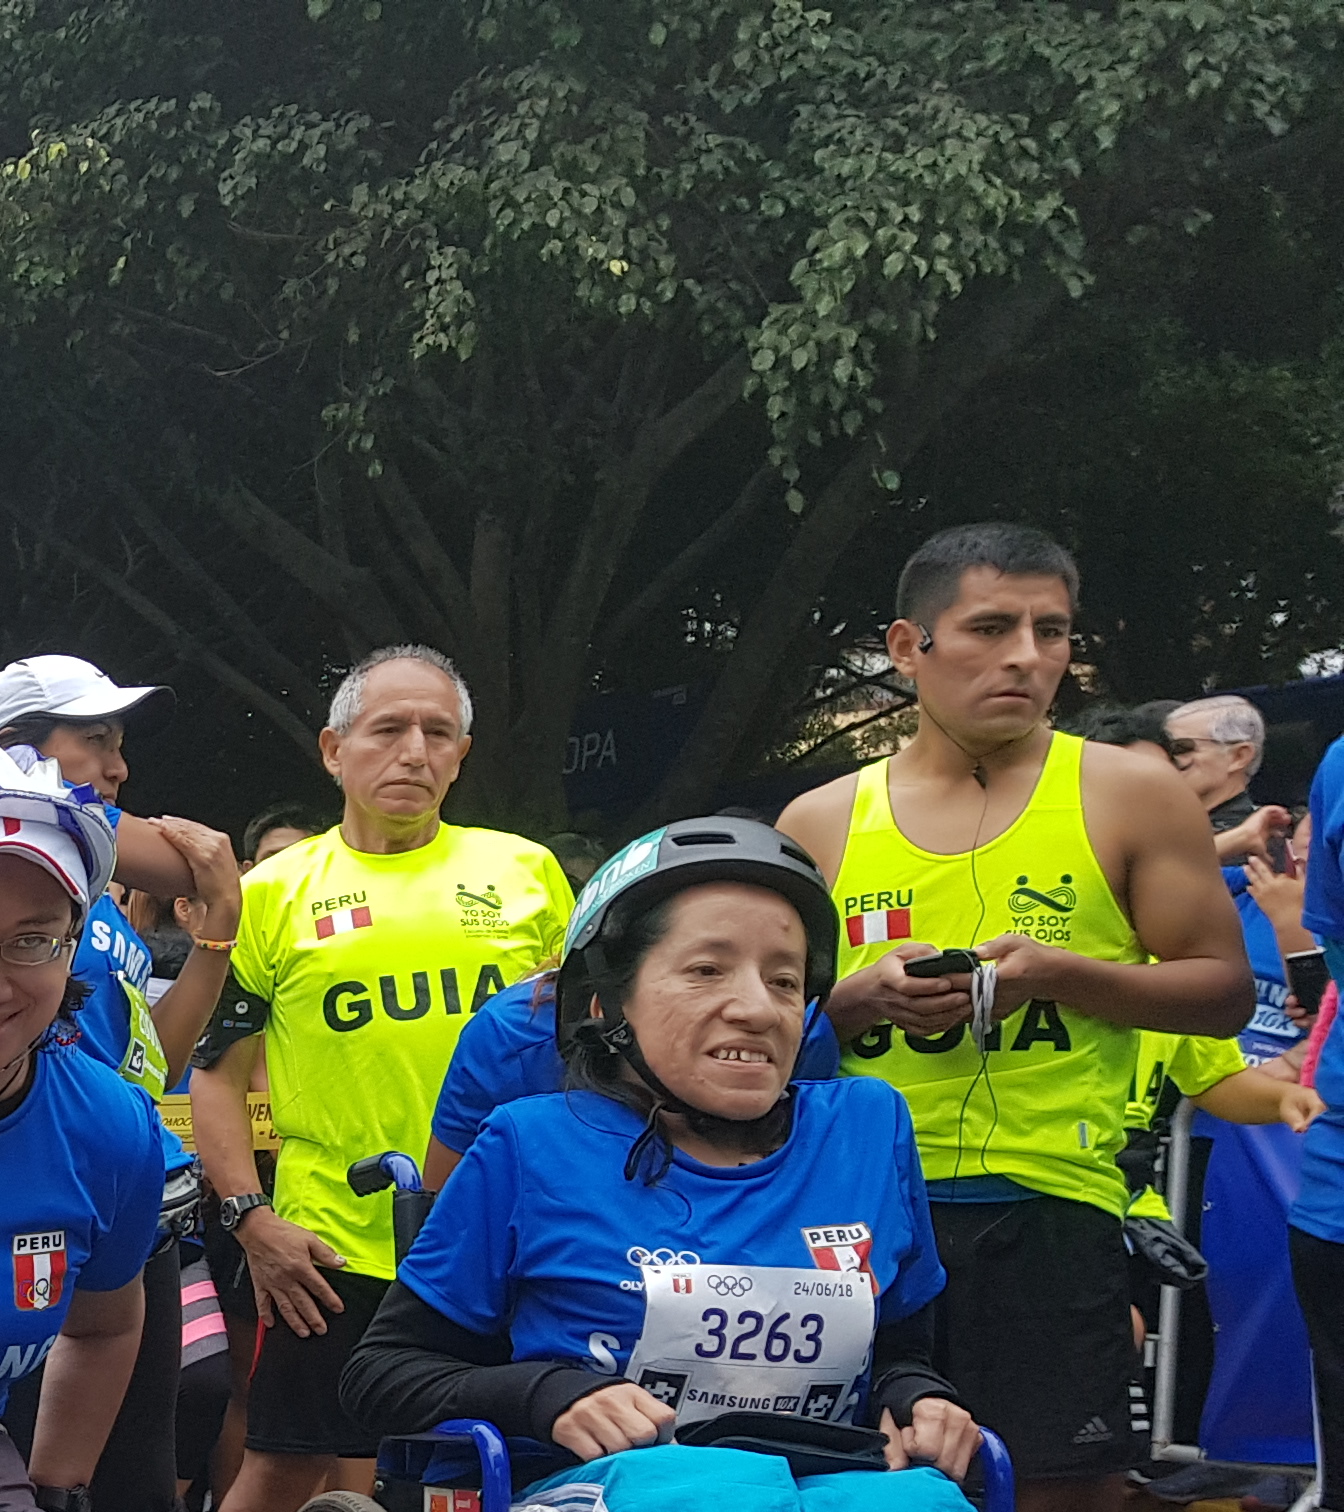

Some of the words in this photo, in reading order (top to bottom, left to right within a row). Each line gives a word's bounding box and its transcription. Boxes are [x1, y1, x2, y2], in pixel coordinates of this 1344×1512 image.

[312, 890, 367, 915] PERU
[845, 888, 913, 916] PERU
[460, 918, 480, 926] SUS
[482, 918, 510, 928] OJOS
[462, 909, 479, 917] YO
[480, 909, 501, 919] SOY
[1011, 915, 1034, 927] YO
[1038, 915, 1071, 927] SOY
[1035, 928, 1071, 943] OJOS
[322, 963, 507, 1033] GUIA
[16, 1233, 63, 1252] PERU
[809, 1227, 863, 1245] PERU
[794, 1281, 854, 1298] 24/06/18
[694, 1307, 825, 1364] 3263
[687, 1389, 771, 1410] SAMSUNG
[774, 1396, 800, 1411] 10K
